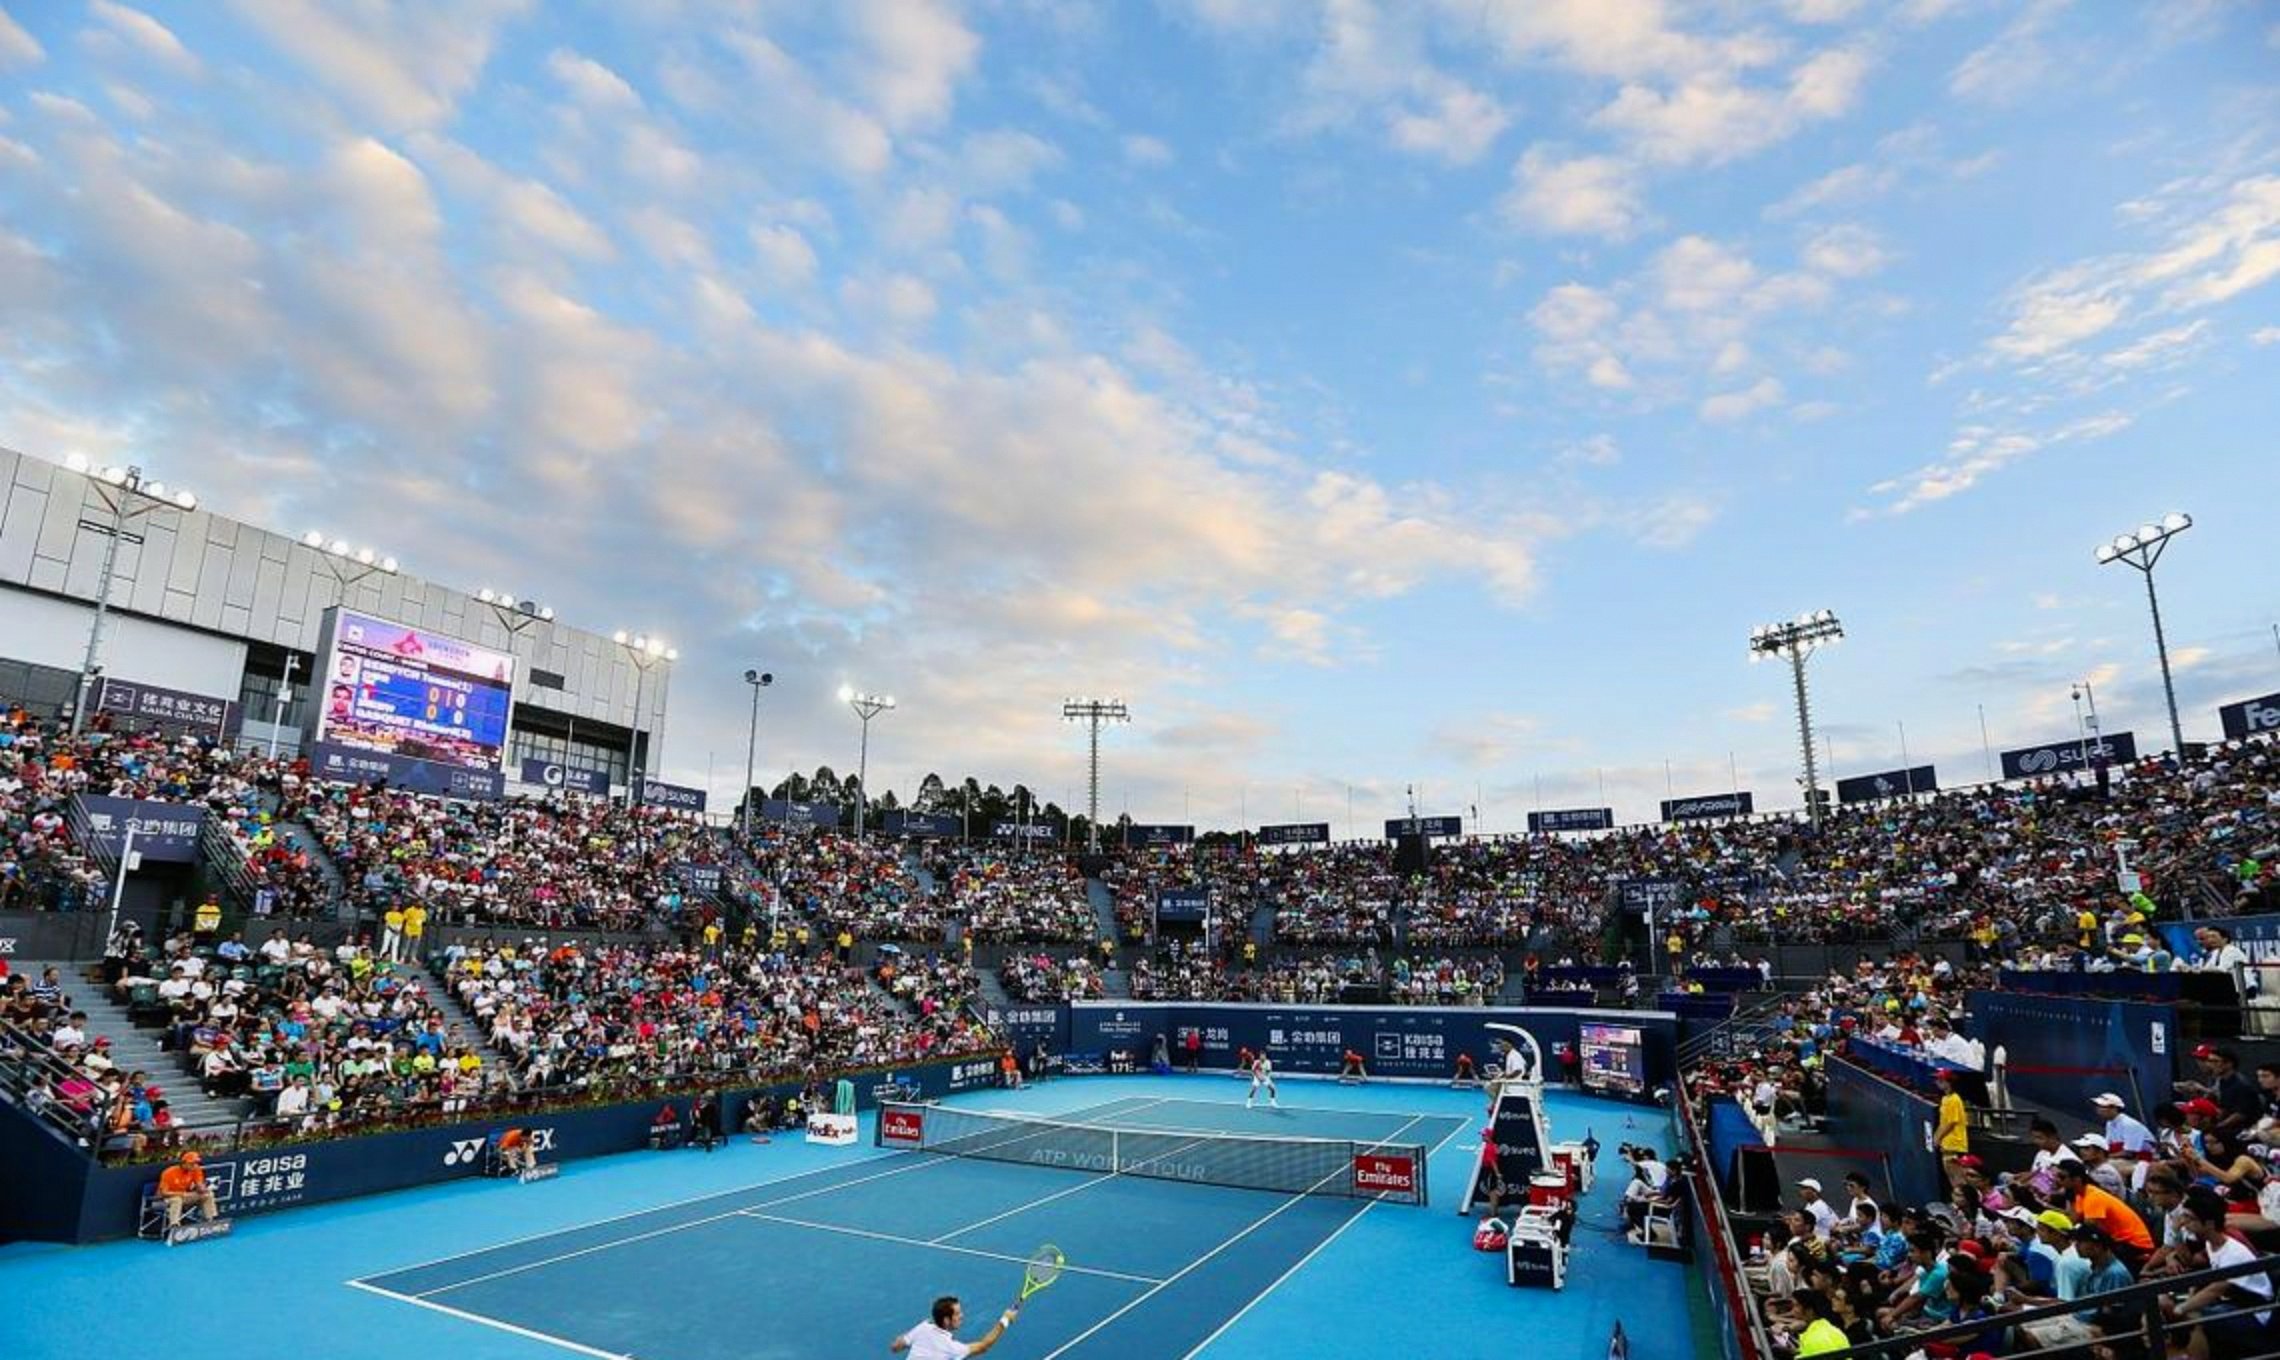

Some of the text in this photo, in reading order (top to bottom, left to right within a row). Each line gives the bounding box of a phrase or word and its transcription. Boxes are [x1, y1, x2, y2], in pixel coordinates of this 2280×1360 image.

[1030, 1148, 1067, 1164] ATP
[1152, 1162, 1206, 1179] TOUR
[241, 1172, 305, 1198] 佳兆业
[1357, 1169, 1410, 1187] Emirates
